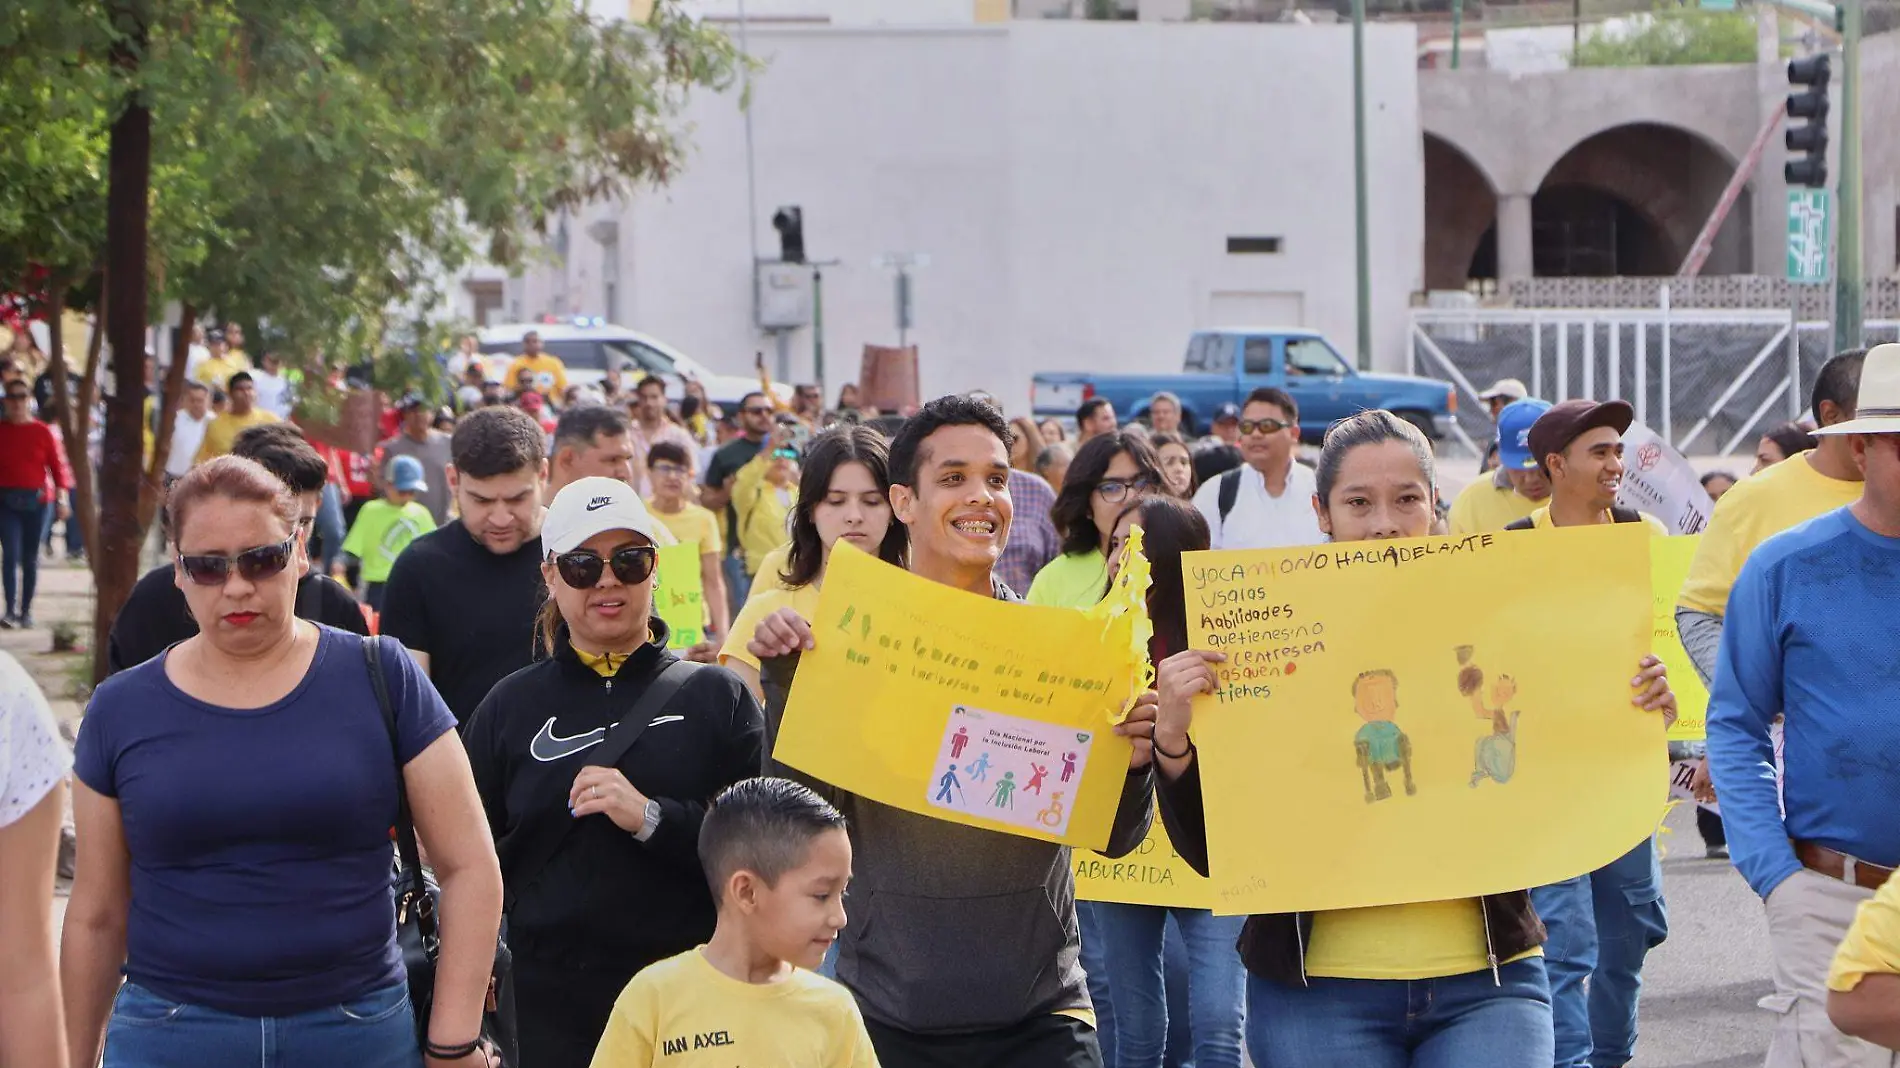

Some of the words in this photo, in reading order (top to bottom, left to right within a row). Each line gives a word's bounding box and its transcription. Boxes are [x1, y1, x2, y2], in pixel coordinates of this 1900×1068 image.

[591, 496, 612, 506] NIKE
[1002, 732, 1034, 745] Nacional
[1024, 745, 1051, 757] Laboral
[1075, 860, 1175, 886] ABURRIDA
[662, 1036, 688, 1056] IAN
[693, 1030, 735, 1051] AXEL
